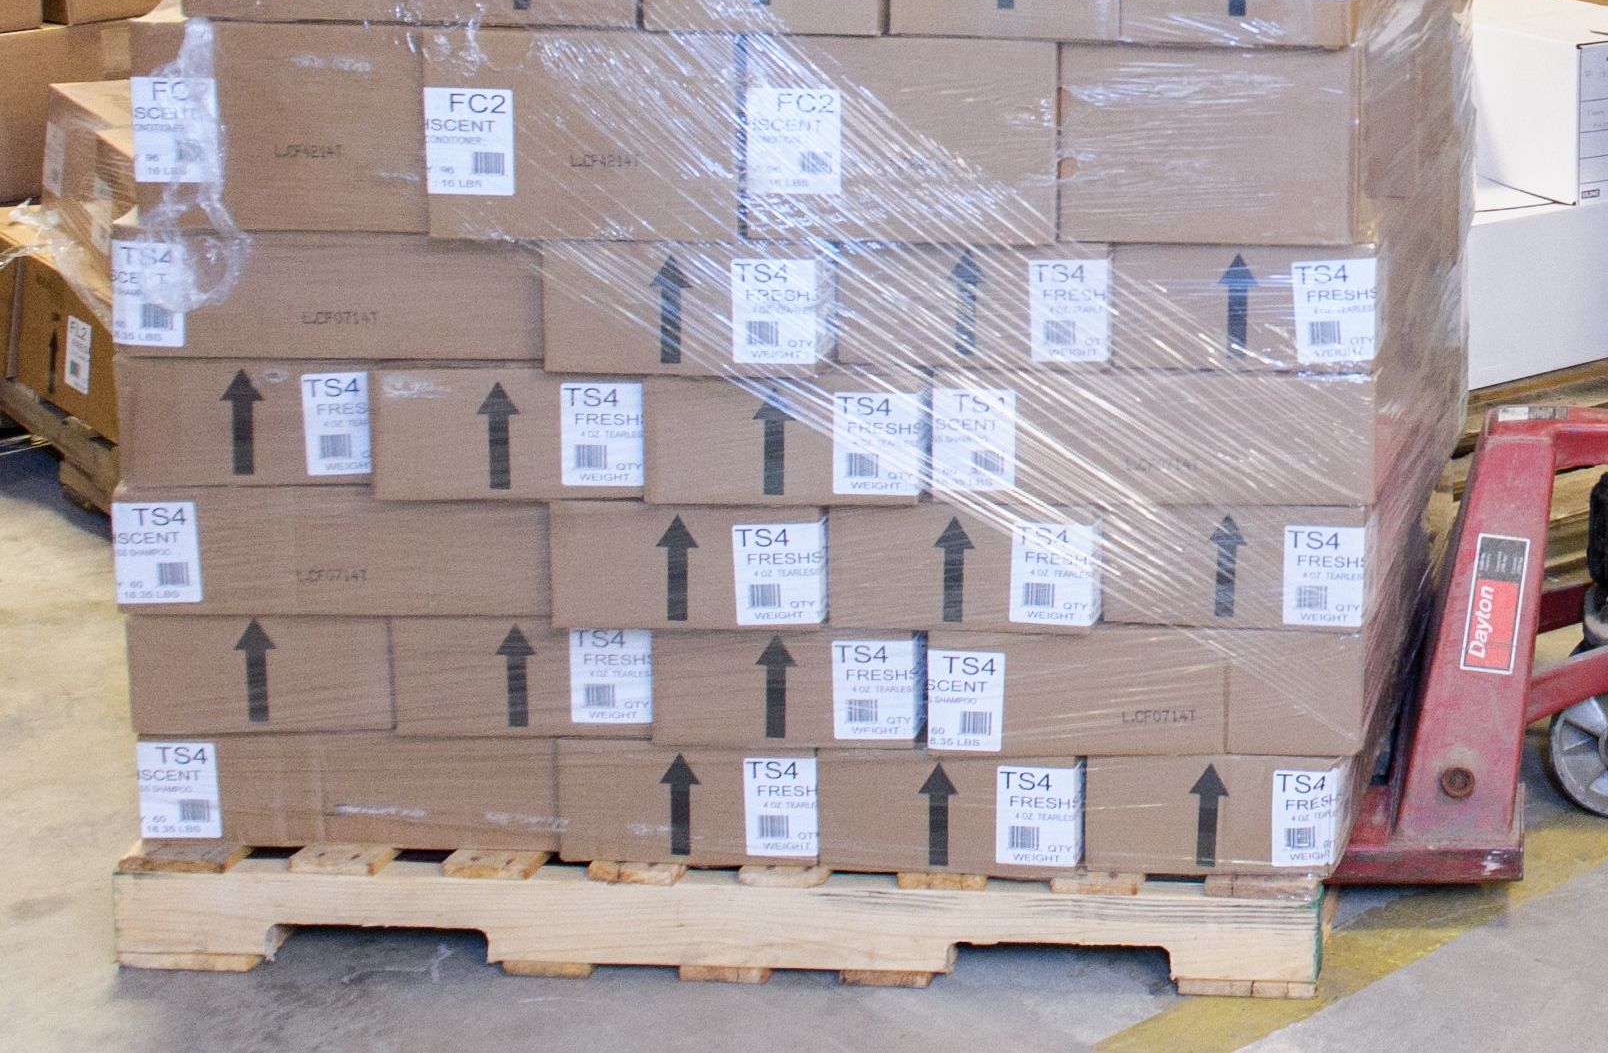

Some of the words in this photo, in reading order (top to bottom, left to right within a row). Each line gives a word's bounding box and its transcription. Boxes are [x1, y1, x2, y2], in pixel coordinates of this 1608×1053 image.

[450, 93, 506, 114] FC2
[777, 93, 834, 113] FC2
[734, 263, 788, 283] TS4
[1035, 264, 1085, 283] TS4
[1294, 264, 1349, 285] TS4
[304, 378, 360, 398] TS4
[563, 387, 620, 407] TS4
[836, 396, 892, 416] TS4
[580, 473, 631, 482] WEIGHT
[851, 481, 901, 490] WEIGHT
[132, 507, 187, 527] TS4
[734, 528, 790, 547] TS4
[1287, 530, 1341, 550] TS4
[790, 600, 816, 608] QTY
[1063, 602, 1088, 610] QTY
[1336, 603, 1360, 612] QTY
[754, 611, 803, 620] WEIGHT
[1027, 610, 1075, 620] WEIGHT
[1300, 613, 1349, 622] WEIGHT
[1468, 585, 1495, 658] Dayton
[572, 629, 627, 648] TS4
[835, 645, 889, 664] TS4
[943, 655, 997, 676] TS4
[589, 711, 638, 720] WEIGHT
[886, 716, 911, 725] QTY
[851, 726, 899, 735] WEIGHT
[957, 737, 981, 747] LBS
[155, 746, 207, 765] TS4
[746, 761, 799, 780] TS4
[1000, 771, 1053, 792] TS4
[1276, 773, 1326, 794] TS4
[1013, 853, 1060, 863] WEIGHT
